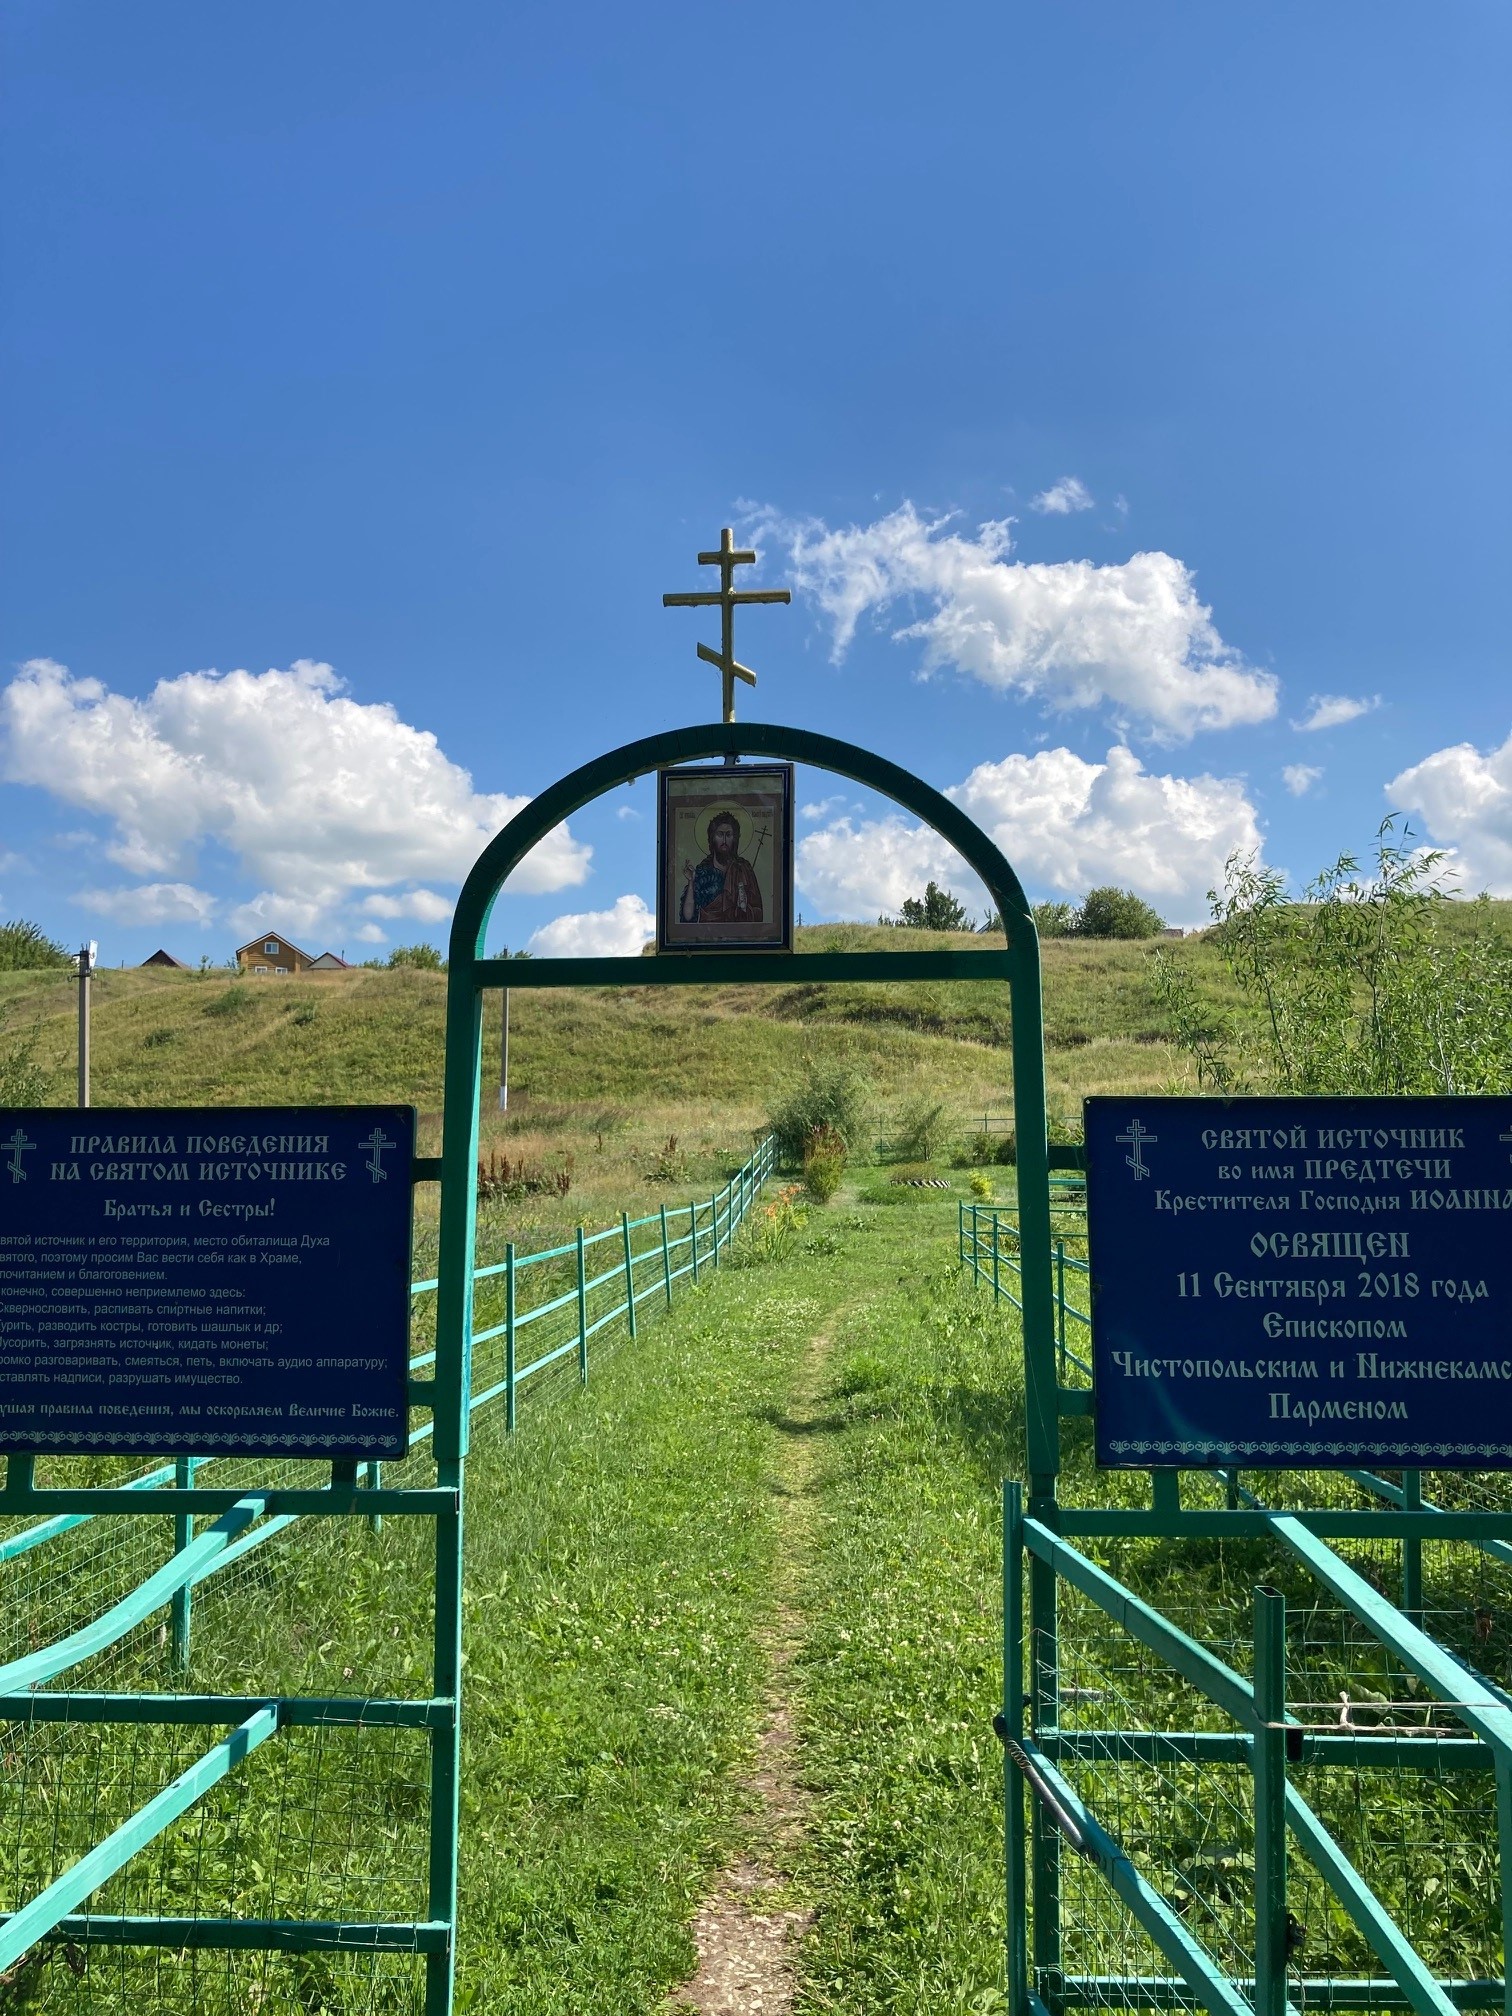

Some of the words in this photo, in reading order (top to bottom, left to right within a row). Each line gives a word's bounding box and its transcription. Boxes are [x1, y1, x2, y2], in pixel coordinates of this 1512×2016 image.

[1201, 1124, 1308, 1149] СВЯТОЙ
[1317, 1128, 1466, 1149] ИСТОЧНИК
[70, 1136, 177, 1153] ПРАВИЛА
[186, 1135, 329, 1157] ПОВЕДЕНИЯ
[50, 1162, 81, 1180] НА
[90, 1162, 190, 1180] СВЯТОМ
[198, 1162, 347, 1180] ИСТОЧНИКЕ
[1218, 1165, 1242, 1180] во
[1251, 1165, 1295, 1180] имя
[1303, 1159, 1452, 1183] ПРЕДТЕЧИ
[103, 1199, 172, 1221] Братья
[180, 1205, 190, 1216] и
[199, 1198, 275, 1221] Сестры!
[1154, 1189, 1290, 1216] Крестителя
[1299, 1190, 1400, 1214] Господня
[1409, 1189, 1512, 1210] ИОАННА
[35, 1235, 85, 1245] источник
[88, 1236, 95, 1245] и
[98, 1236, 117, 1245] его
[193, 1236, 228, 1245] место
[231, 1234, 298, 1247] обиталища
[301, 1234, 330, 1248] Духа
[1250, 1231, 1411, 1265] ОСВЯЩЕН
[41, 1253, 88, 1265] поэтому
[91, 1253, 133, 1265] просим
[137, 1251, 158, 1262] Вас
[162, 1253, 194, 1262] вести
[197, 1251, 224, 1262] себя
[228, 1253, 246, 1262] как
[250, 1253, 257, 1262] в
[68, 1270, 75, 1279] и
[1, 1287, 48, 1298] конечно,
[51, 1287, 122, 1299] совершенно
[126, 1288, 206, 1299] неприемлемо
[1177, 1272, 1202, 1298] 11
[1213, 1272, 1346, 1306] Сентября
[1357, 1272, 1420, 1298] 2018
[1431, 1279, 1490, 1304] года
[94, 1304, 153, 1316] распивать
[157, 1304, 212, 1316] спиртные
[0, 1318, 34, 1332] урить,
[38, 1321, 97, 1332] разводить
[148, 1321, 197, 1332] готовить
[201, 1322, 250, 1332] шашлык
[254, 1323, 261, 1332] и
[1262, 1312, 1408, 1338] Епископом
[0, 1336, 49, 1350] усорить,
[53, 1338, 116, 1350] загрязнять
[178, 1339, 217, 1350] кидать
[219, 1357, 274, 1366] включать
[278, 1357, 312, 1369] аудио
[1111, 1351, 1319, 1379] Чистопольским
[1330, 1360, 1344, 1378] и
[1356, 1352, 1512, 1380] Нижнекамс
[109, 1373, 171, 1385] разрушать
[40, 1404, 93, 1417] правила
[179, 1405, 200, 1415] мы
[206, 1405, 283, 1419] оскорбляем
[289, 1403, 346, 1417] Величие
[1268, 1393, 1408, 1427] Парменом
